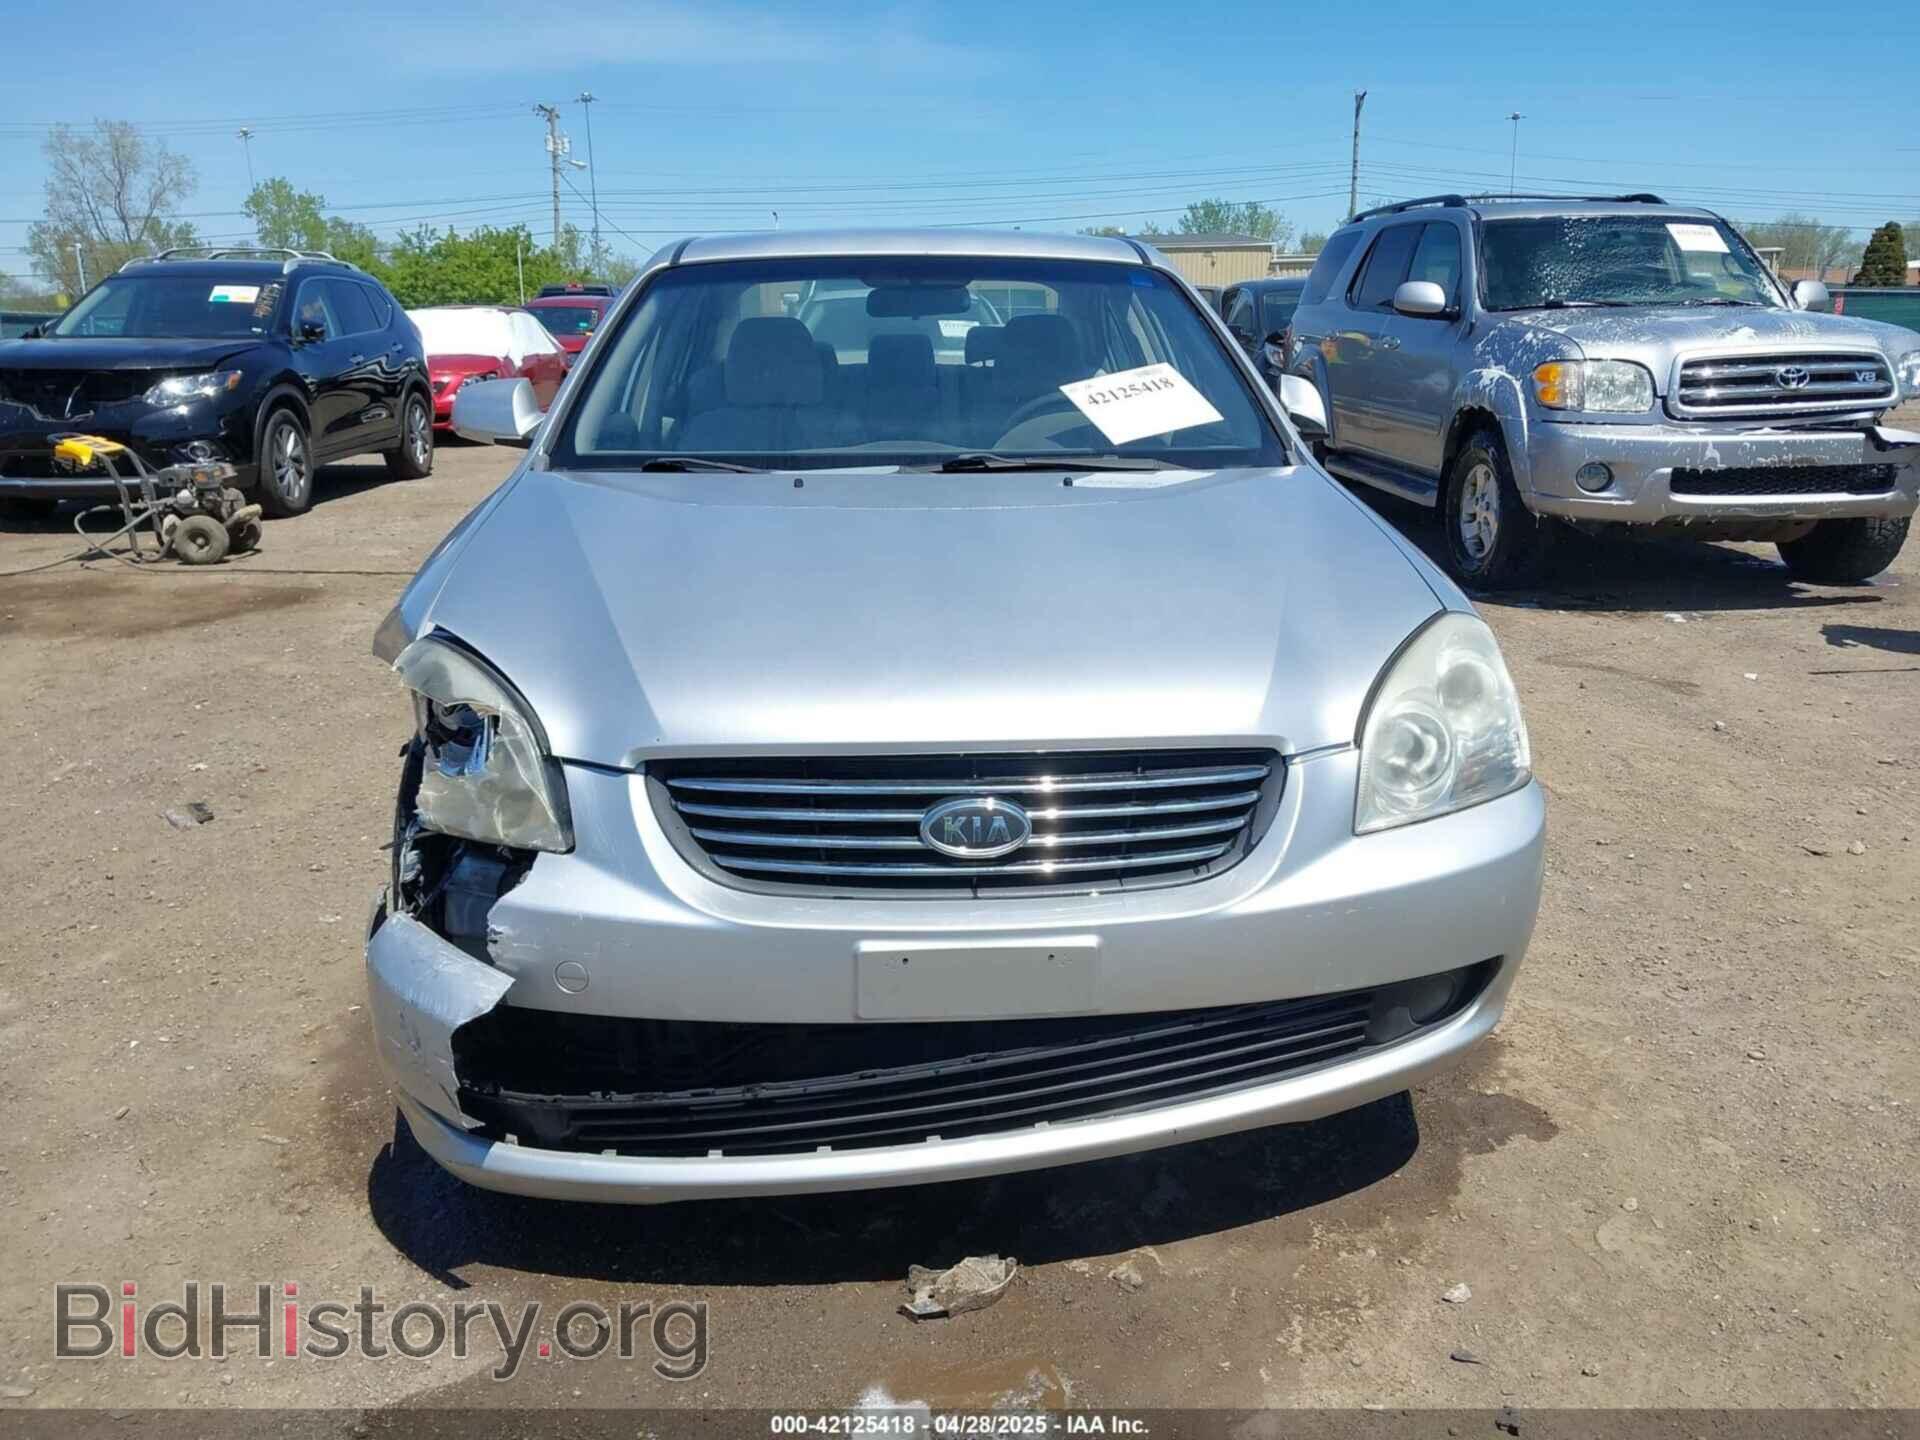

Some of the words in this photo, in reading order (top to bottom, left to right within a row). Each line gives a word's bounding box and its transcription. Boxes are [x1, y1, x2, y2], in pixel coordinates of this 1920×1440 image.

[1855, 370, 1877, 382] V8
[1087, 377, 1174, 405] 42125418
[943, 815, 1013, 843] KIA
